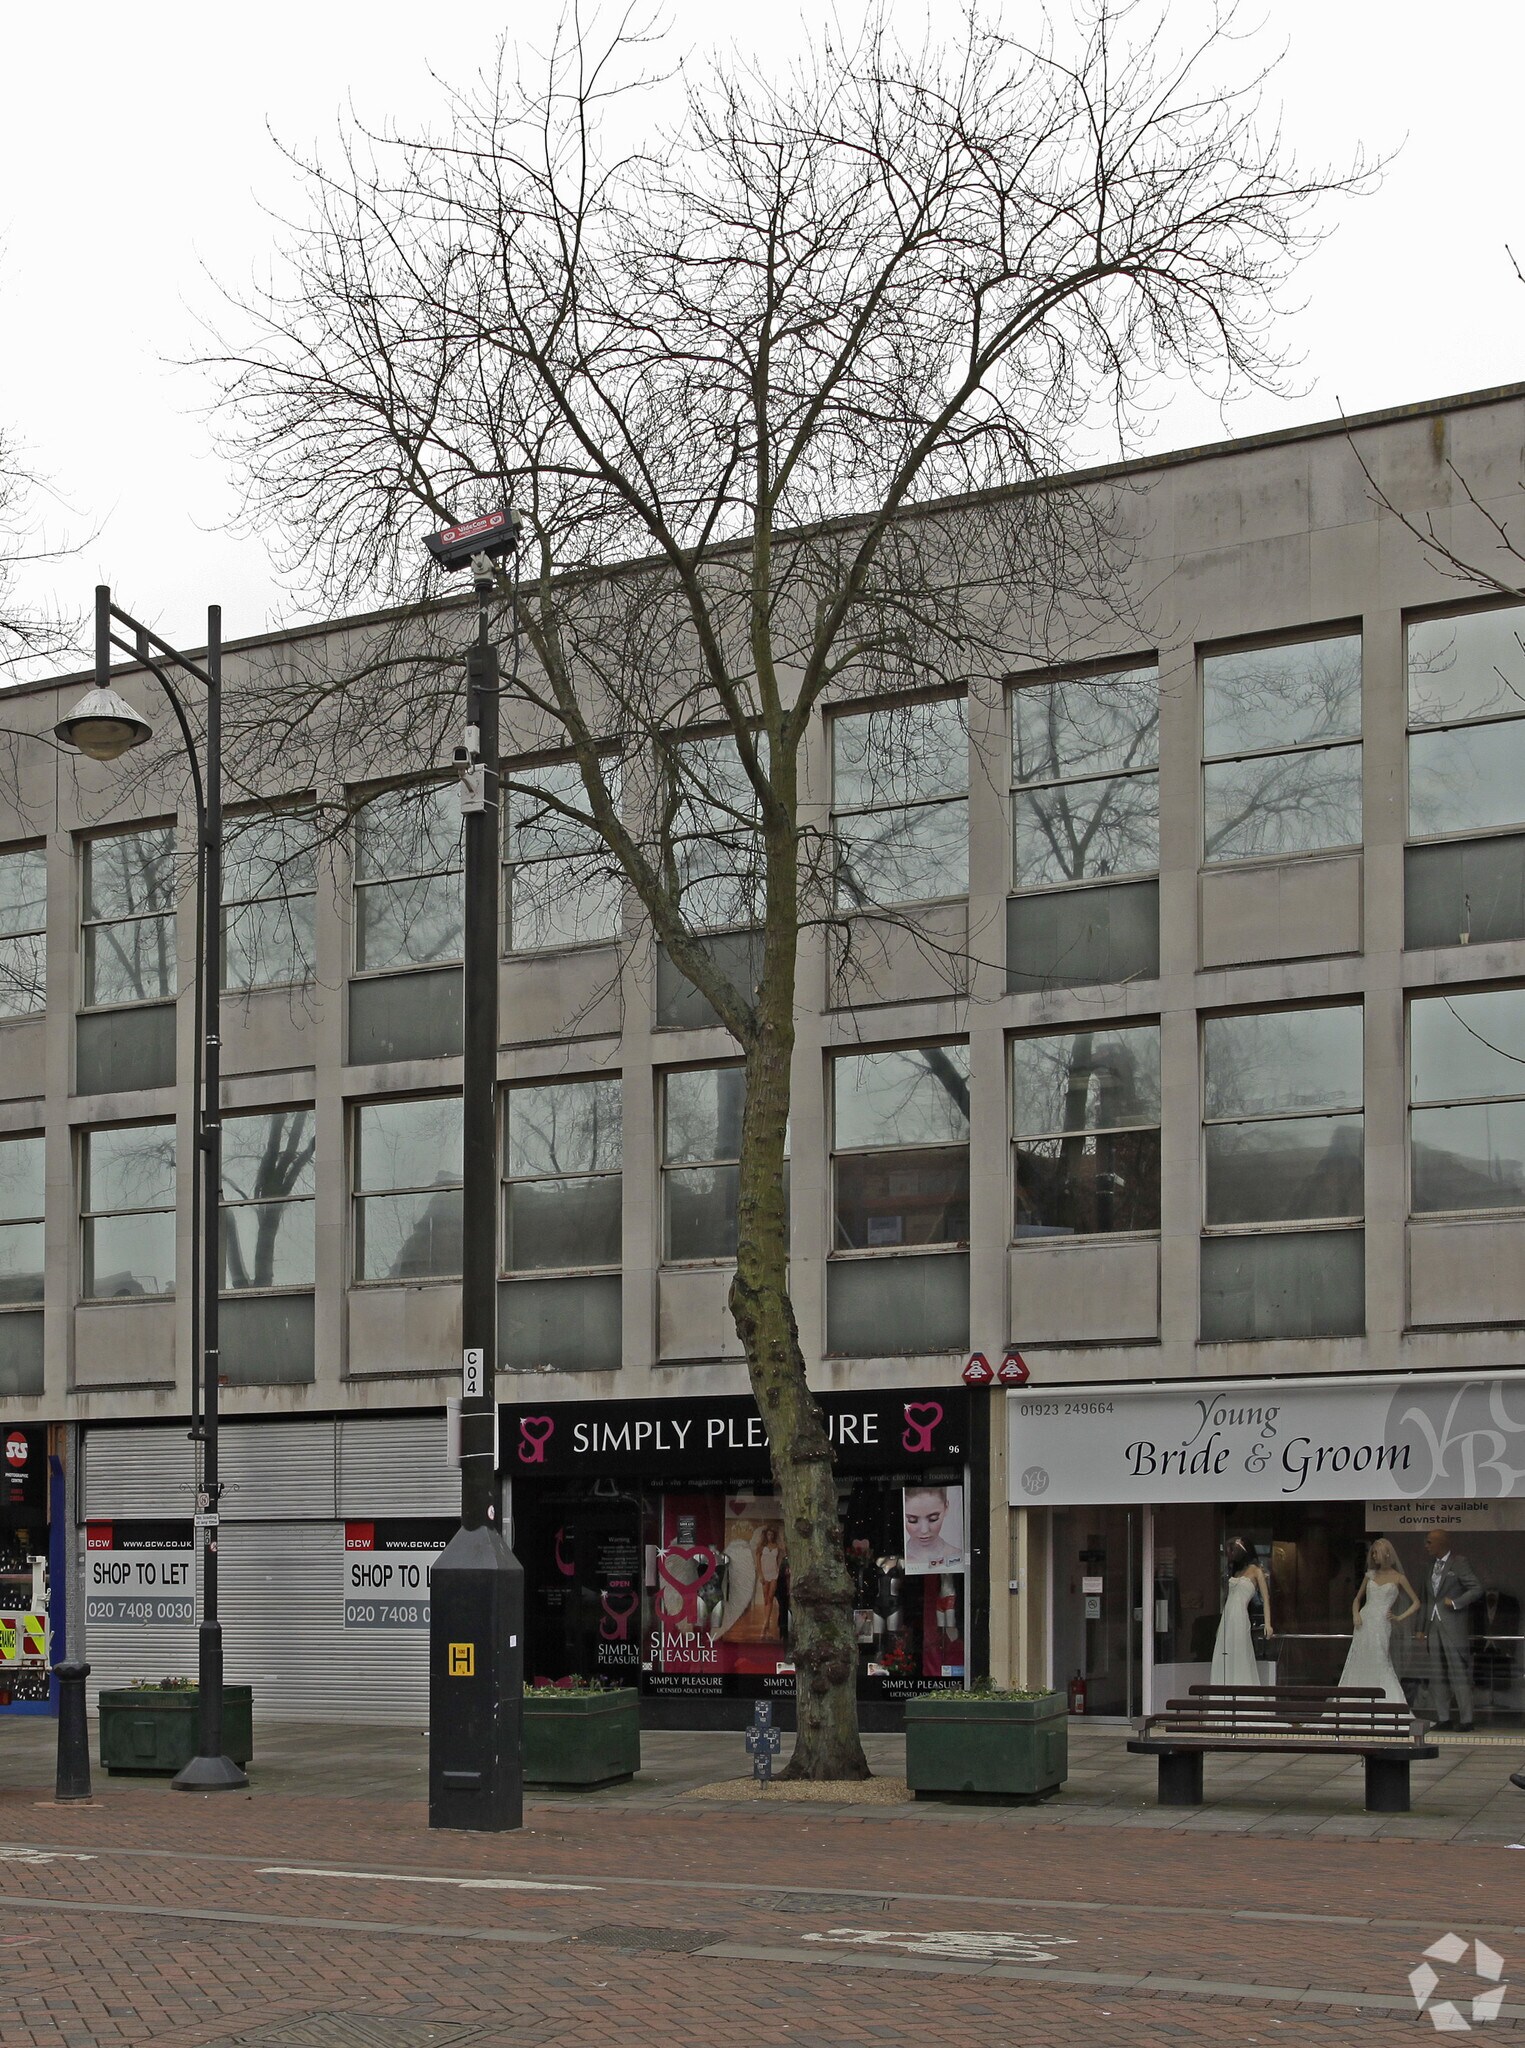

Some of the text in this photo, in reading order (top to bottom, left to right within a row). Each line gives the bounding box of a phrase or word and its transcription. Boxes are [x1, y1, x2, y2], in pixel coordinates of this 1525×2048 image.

[467, 1351, 477, 1394] C04
[1020, 1402, 1114, 1417] 01923 249664
[1182, 1393, 1281, 1447] Young
[573, 1412, 879, 1453] SIMPLY PLERE
[948, 1445, 960, 1454] 96
[1124, 1431, 1411, 1494] Bride & Groom
[1372, 1502, 1489, 1512] Instant hire available
[1399, 1514, 1462, 1524] downstairs
[88, 1539, 110, 1548] GCW
[346, 1540, 371, 1548] GCW
[93, 1562, 189, 1585] SHOP TO LET
[351, 1564, 393, 1588] SHOP
[398, 1564, 420, 1588] TO
[88, 1602, 192, 1619] 020 7408 0030
[347, 1606, 375, 1622] 020
[379, 1606, 418, 1623] 7408
[650, 1631, 718, 1649] SIMPLY
[598, 1643, 640, 1656] SIMPLY
[650, 1649, 718, 1663] PLEASURE
[649, 1676, 723, 1686] SIMPLY PLEASURE
[763, 1679, 795, 1687] SIMPLY
[882, 1679, 914, 1690] SIMPLY
